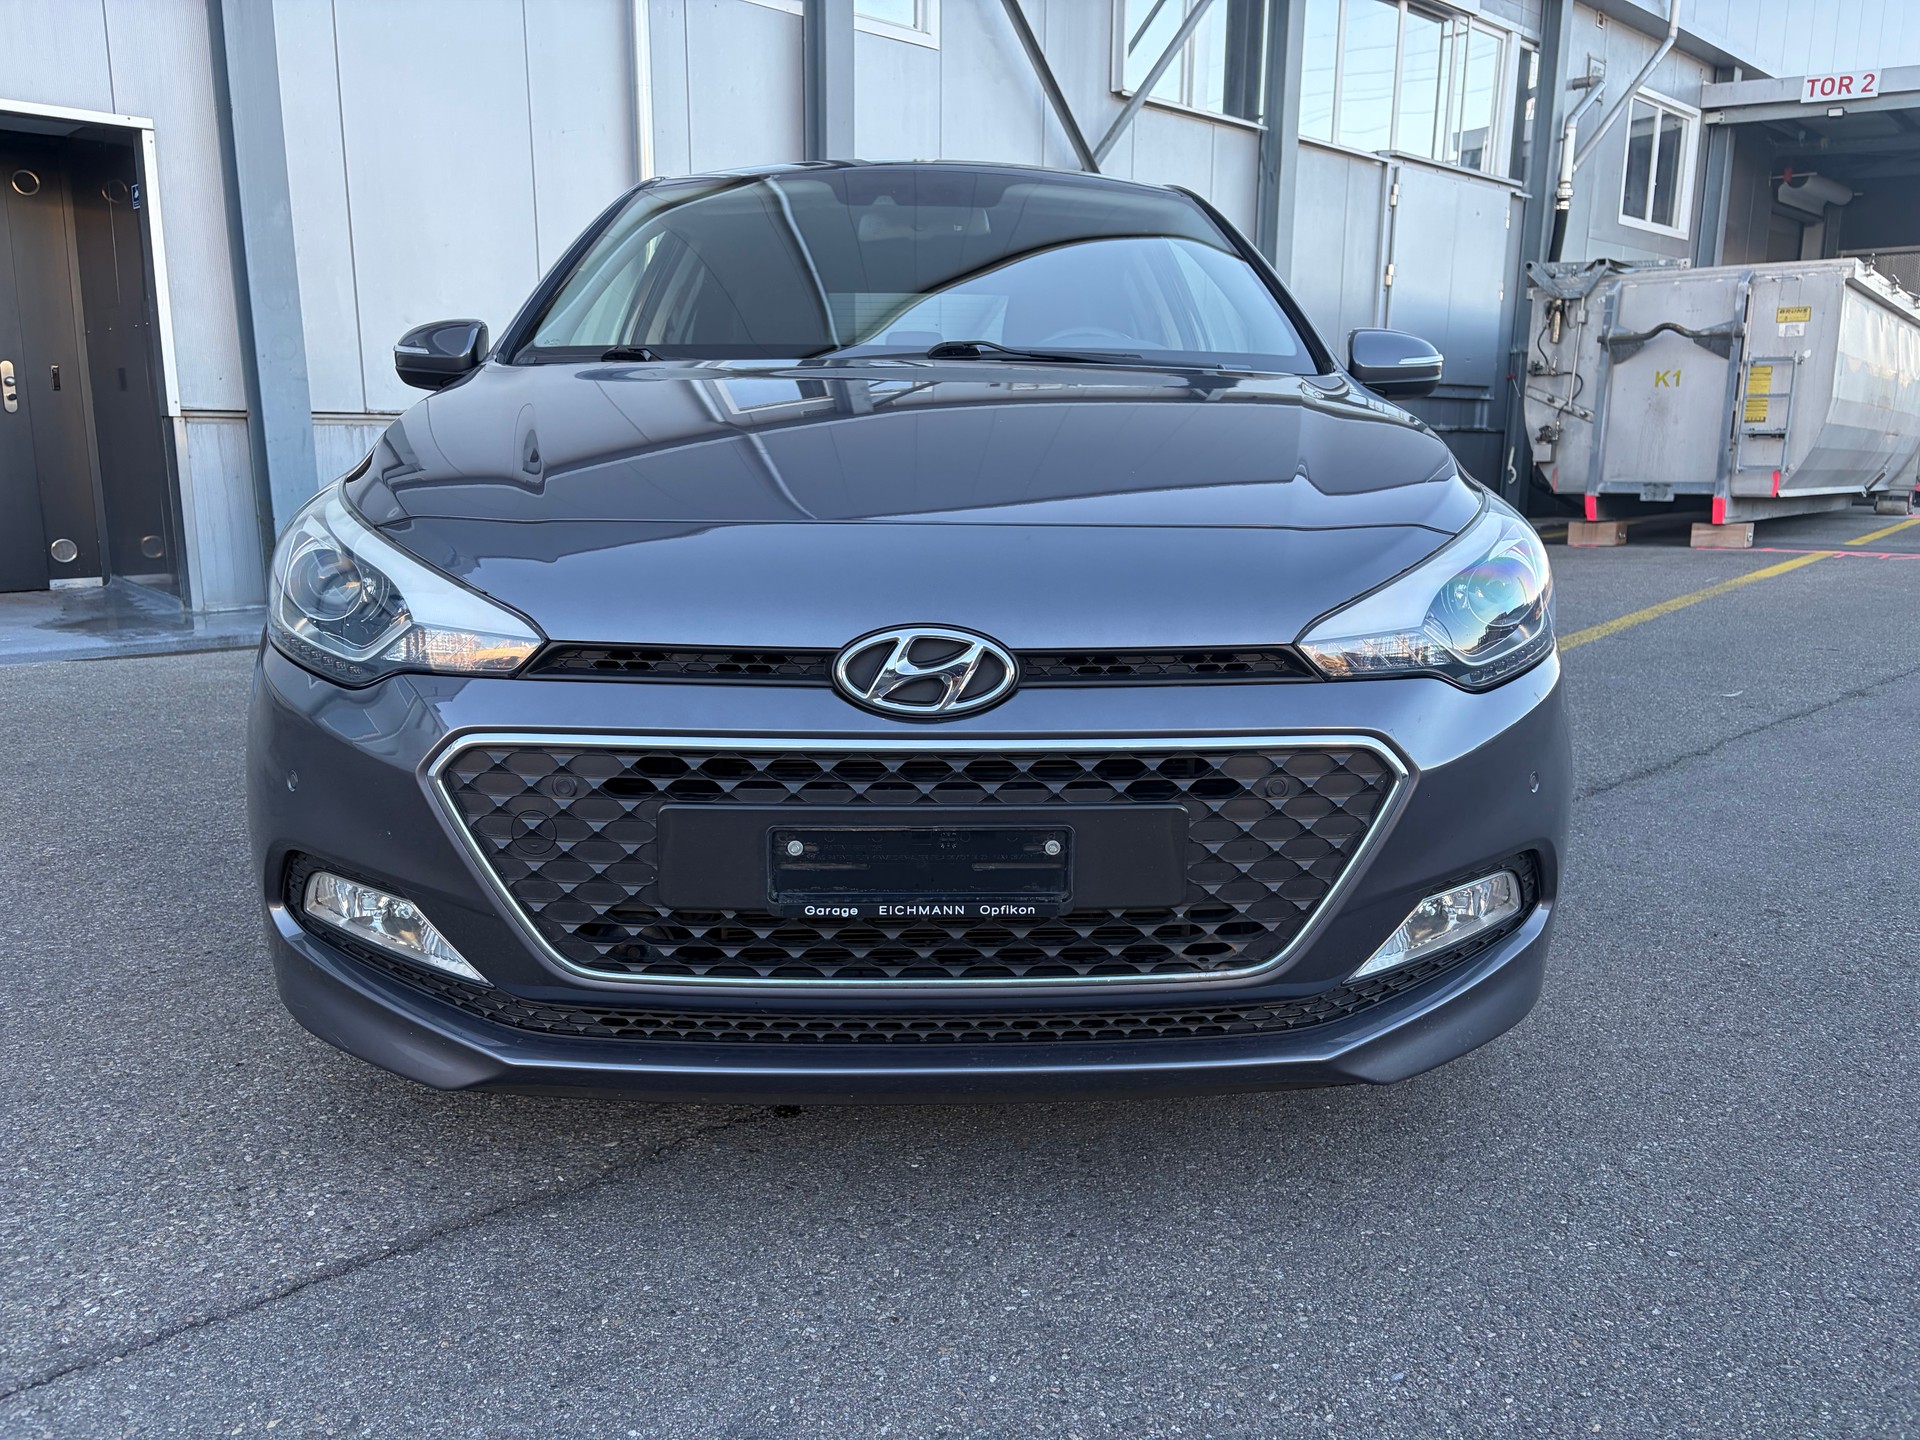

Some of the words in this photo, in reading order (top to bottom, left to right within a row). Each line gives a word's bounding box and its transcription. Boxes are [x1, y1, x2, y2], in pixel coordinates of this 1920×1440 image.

[1807, 76, 1854, 98] TOR
[1861, 73, 1876, 93] 2
[1654, 369, 1681, 388] K1
[804, 905, 859, 918] Garage
[879, 905, 965, 915] EICHMANN
[979, 904, 1036, 917] Opfikon
